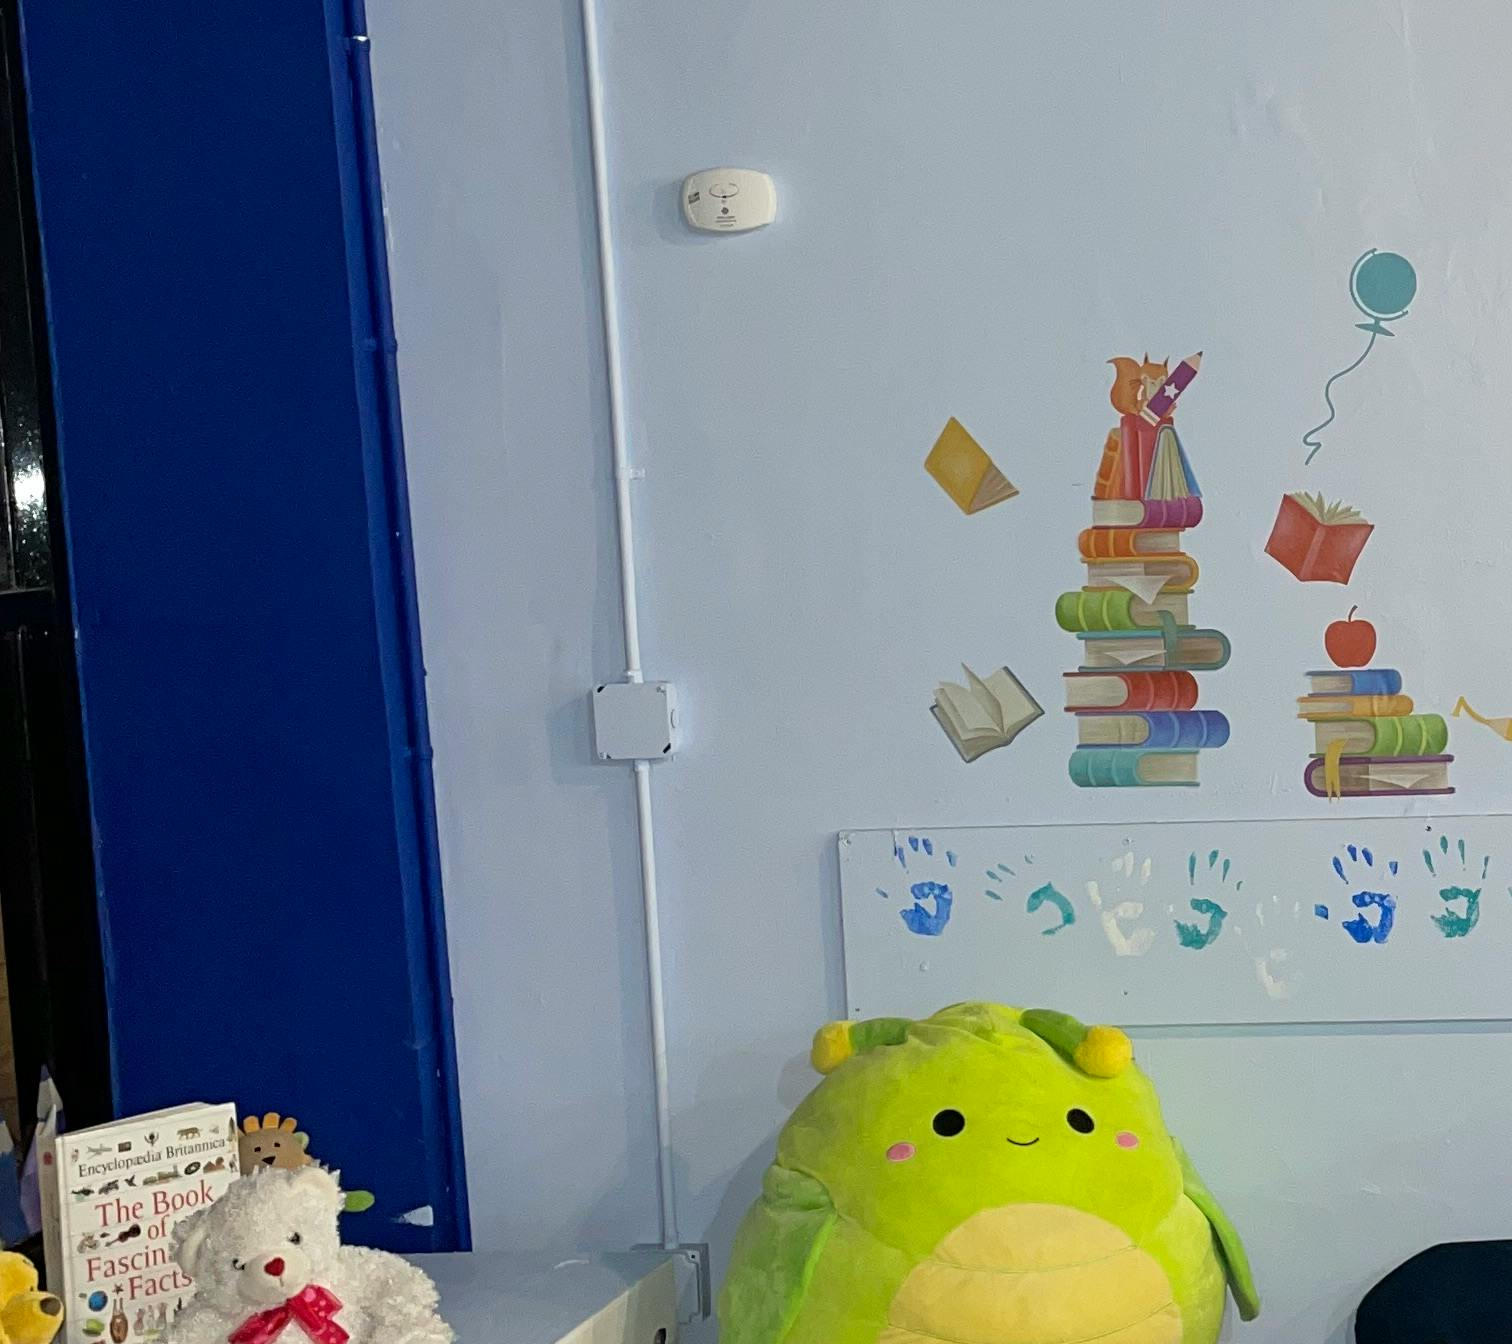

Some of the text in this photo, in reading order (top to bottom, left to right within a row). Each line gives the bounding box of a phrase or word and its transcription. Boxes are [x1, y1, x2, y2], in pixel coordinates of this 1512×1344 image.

[78, 1138, 225, 1178] Encyclopædia Britannica
[95, 1179, 214, 1227] The Book
[147, 1214, 170, 1240] of
[86, 1245, 167, 1282] Fascin
[128, 1269, 193, 1300] Facts
